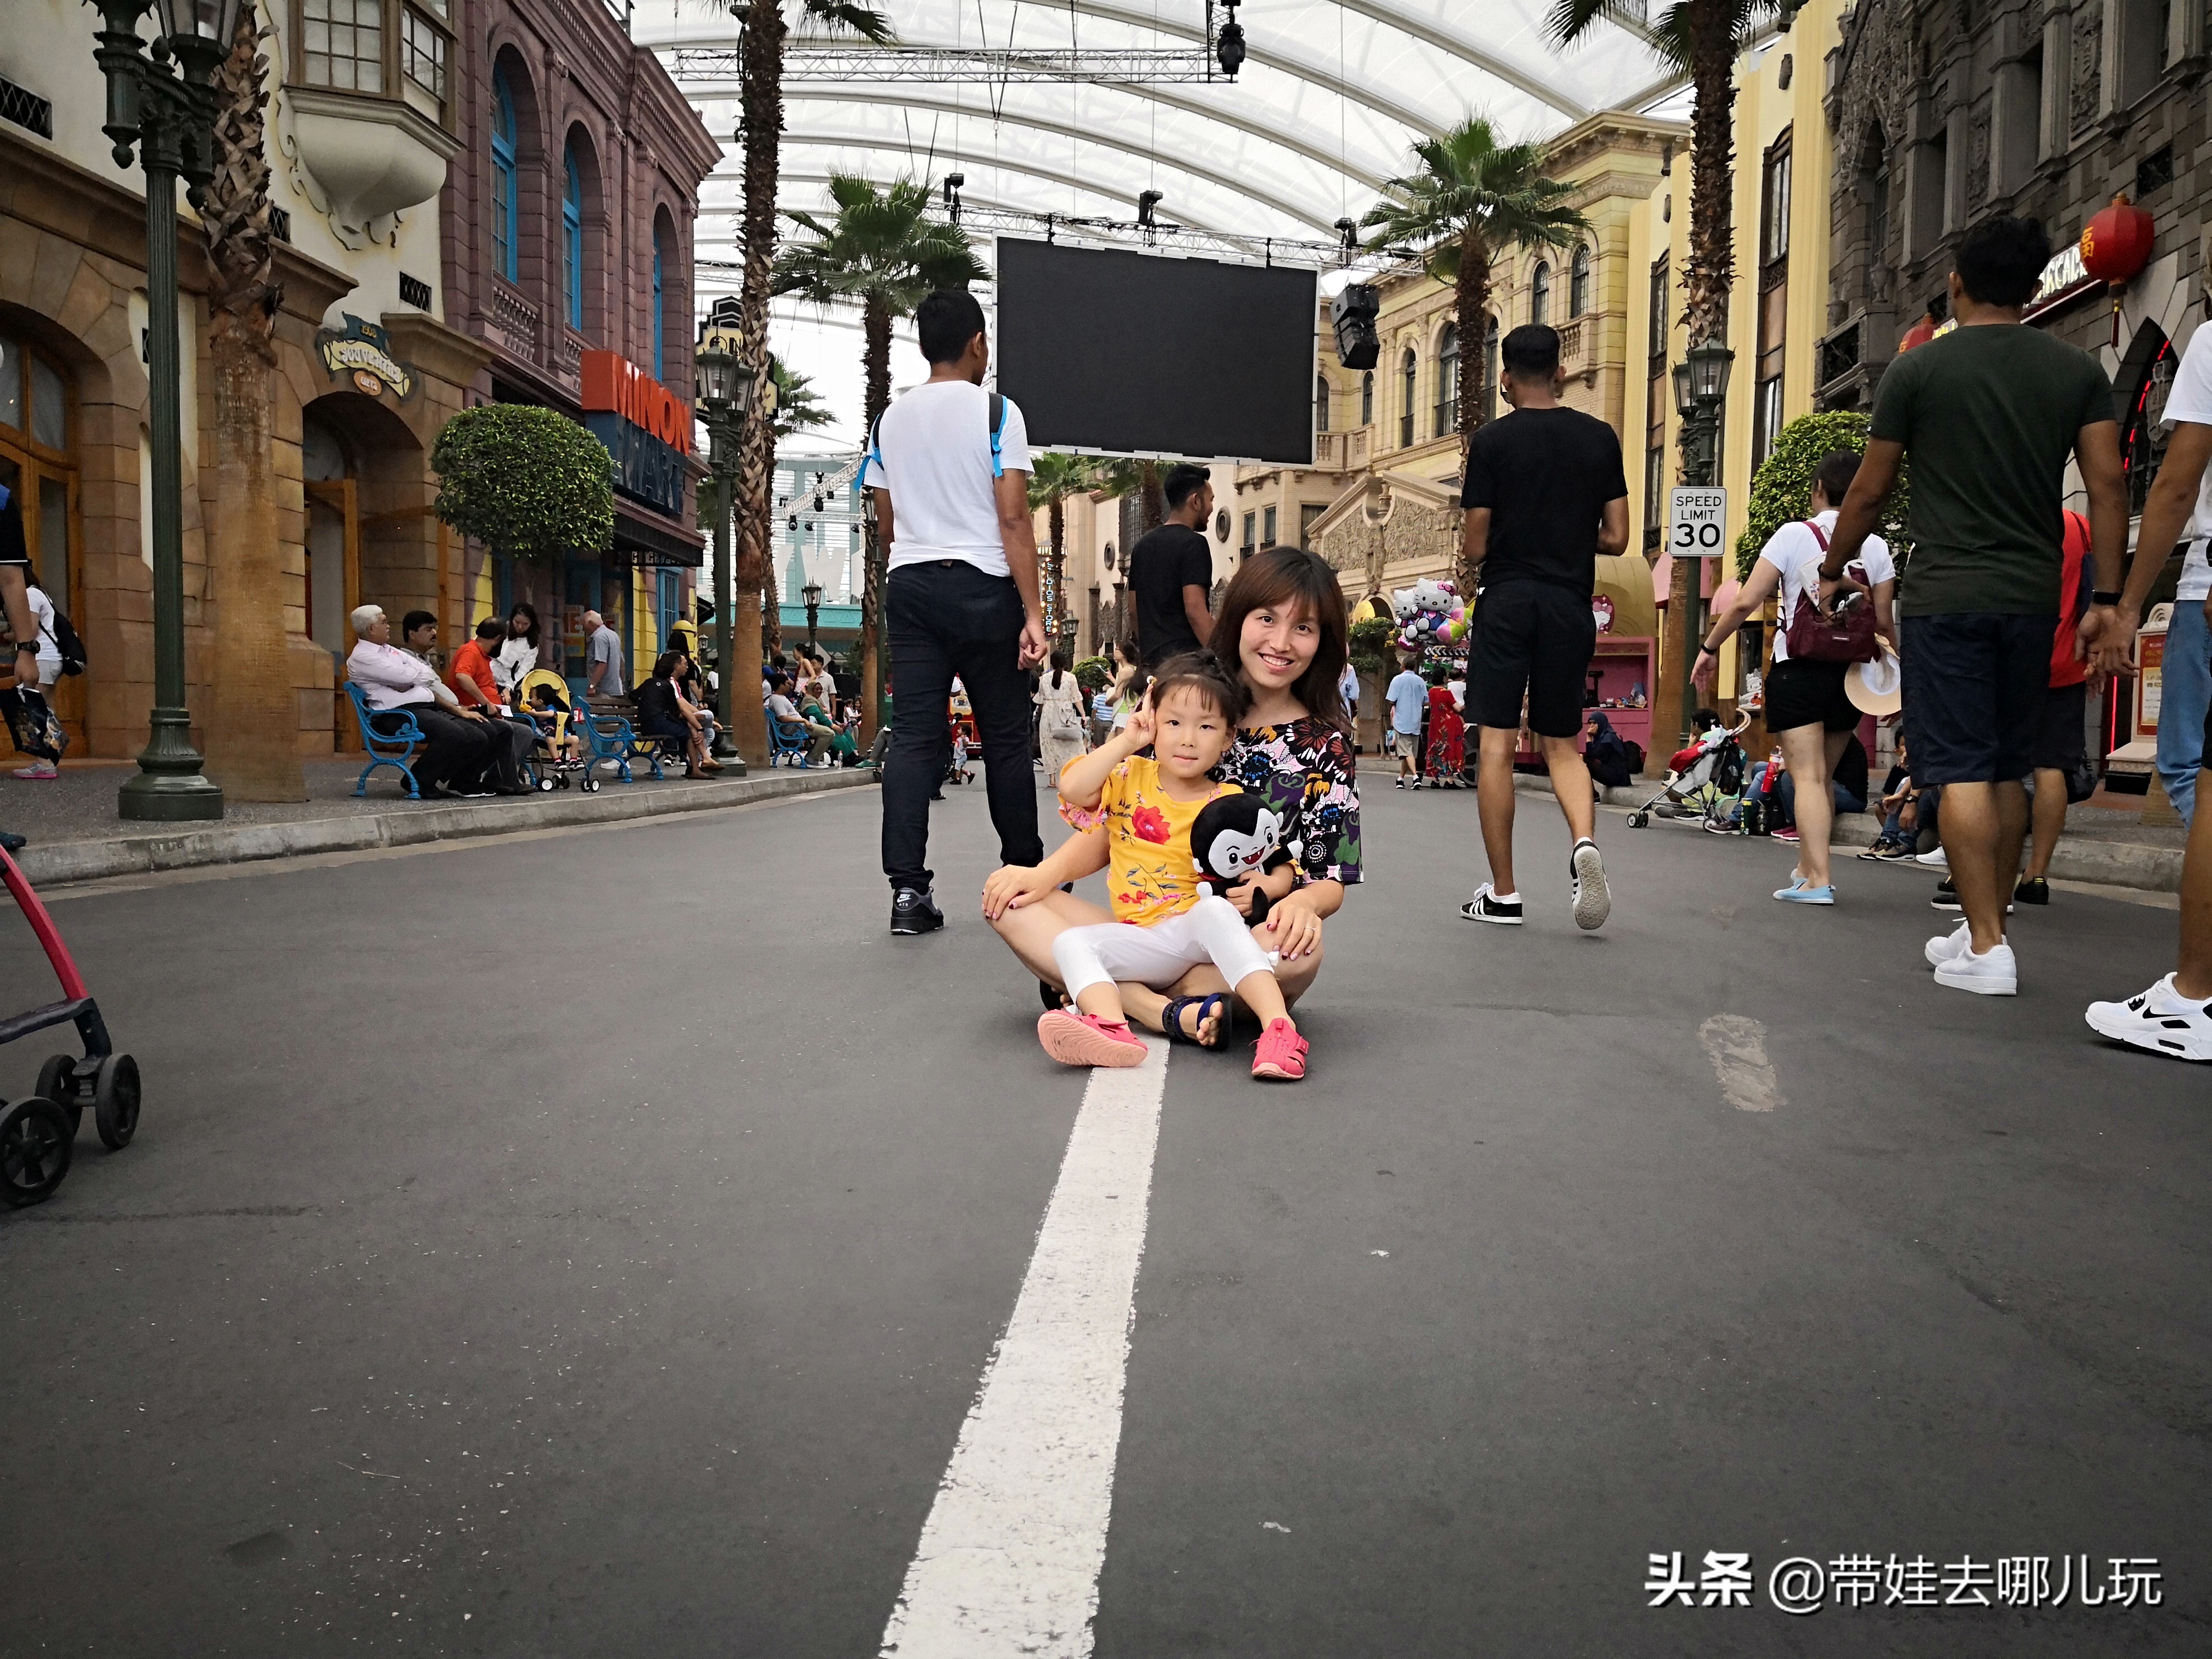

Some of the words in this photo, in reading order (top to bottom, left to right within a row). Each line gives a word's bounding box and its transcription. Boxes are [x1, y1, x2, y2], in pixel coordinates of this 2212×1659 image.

[1676, 496, 1721, 507] SPEED
[1681, 510, 1715, 520] LIMIT
[1674, 523, 1720, 547] 30
[1036, 546, 1068, 555] NIVEAL
